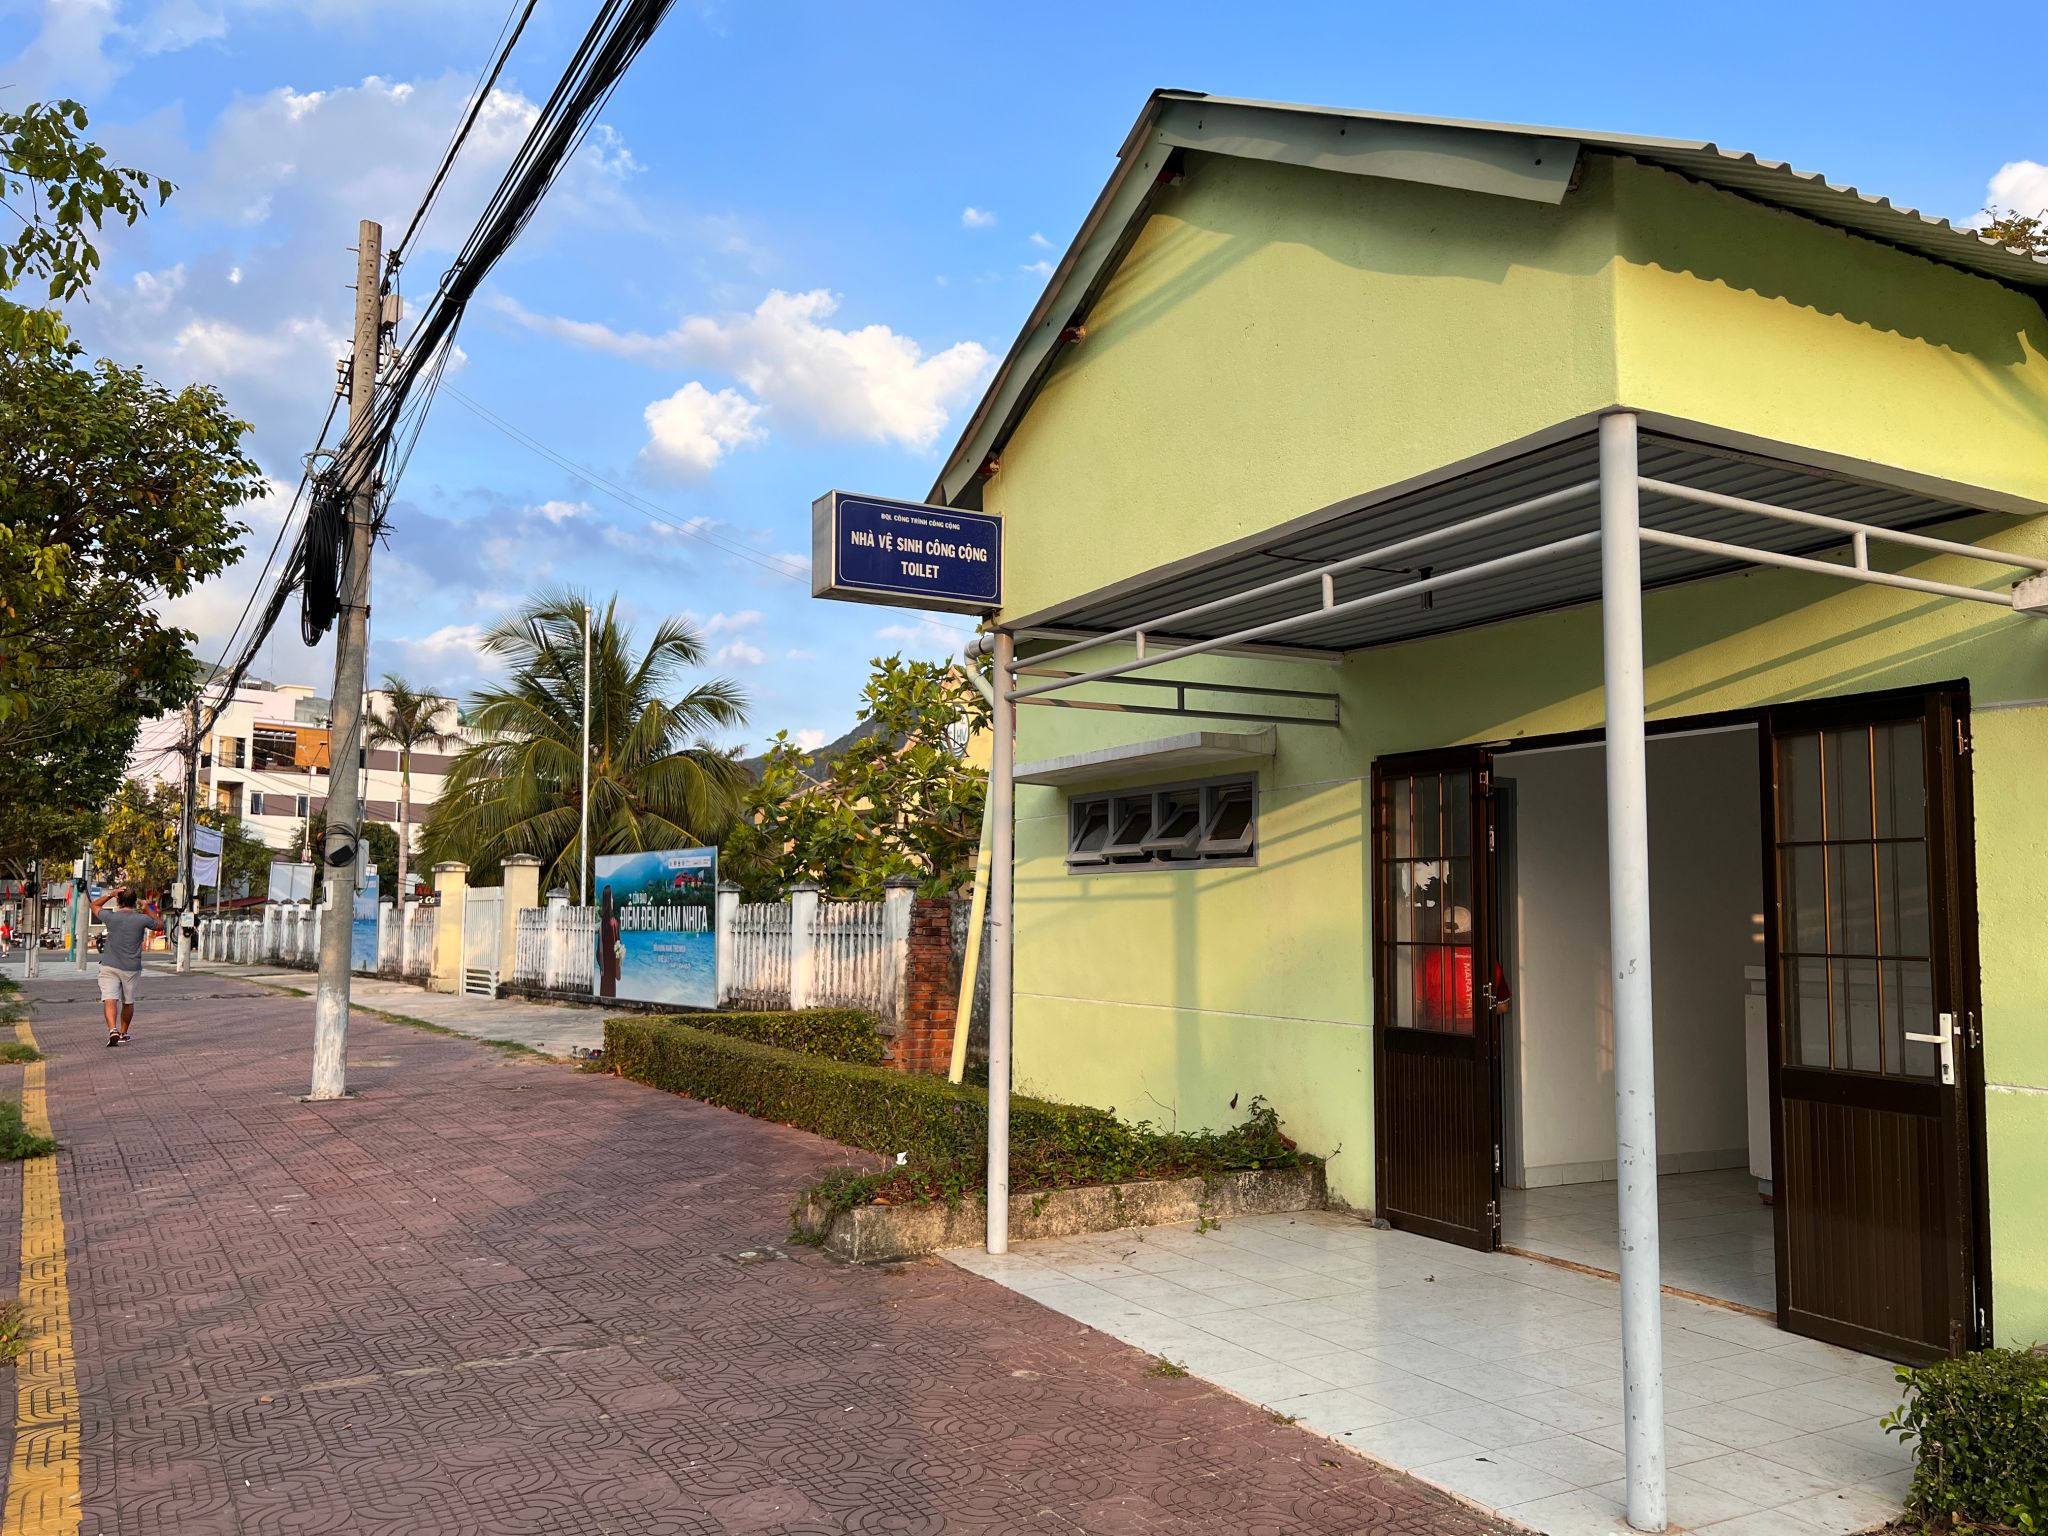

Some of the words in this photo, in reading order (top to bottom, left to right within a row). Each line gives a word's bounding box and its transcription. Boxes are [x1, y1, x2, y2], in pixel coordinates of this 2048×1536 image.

[894, 514, 909, 523] CÔNG
[911, 516, 927, 525] TRÌNH
[929, 519, 944, 528] CÔNG
[851, 529, 874, 547] NHÀ
[878, 533, 893, 552] VỆ
[897, 537, 922, 553] SINH
[926, 539, 955, 558] CÔNG
[958, 543, 987, 563] CỘNG
[901, 561, 939, 579] TOILET
[620, 894, 639, 930] ĐIỂM
[641, 896, 657, 931] ĐẾN
[659, 899, 680, 931] GIẢM
[682, 905, 708, 938] NHỰA
